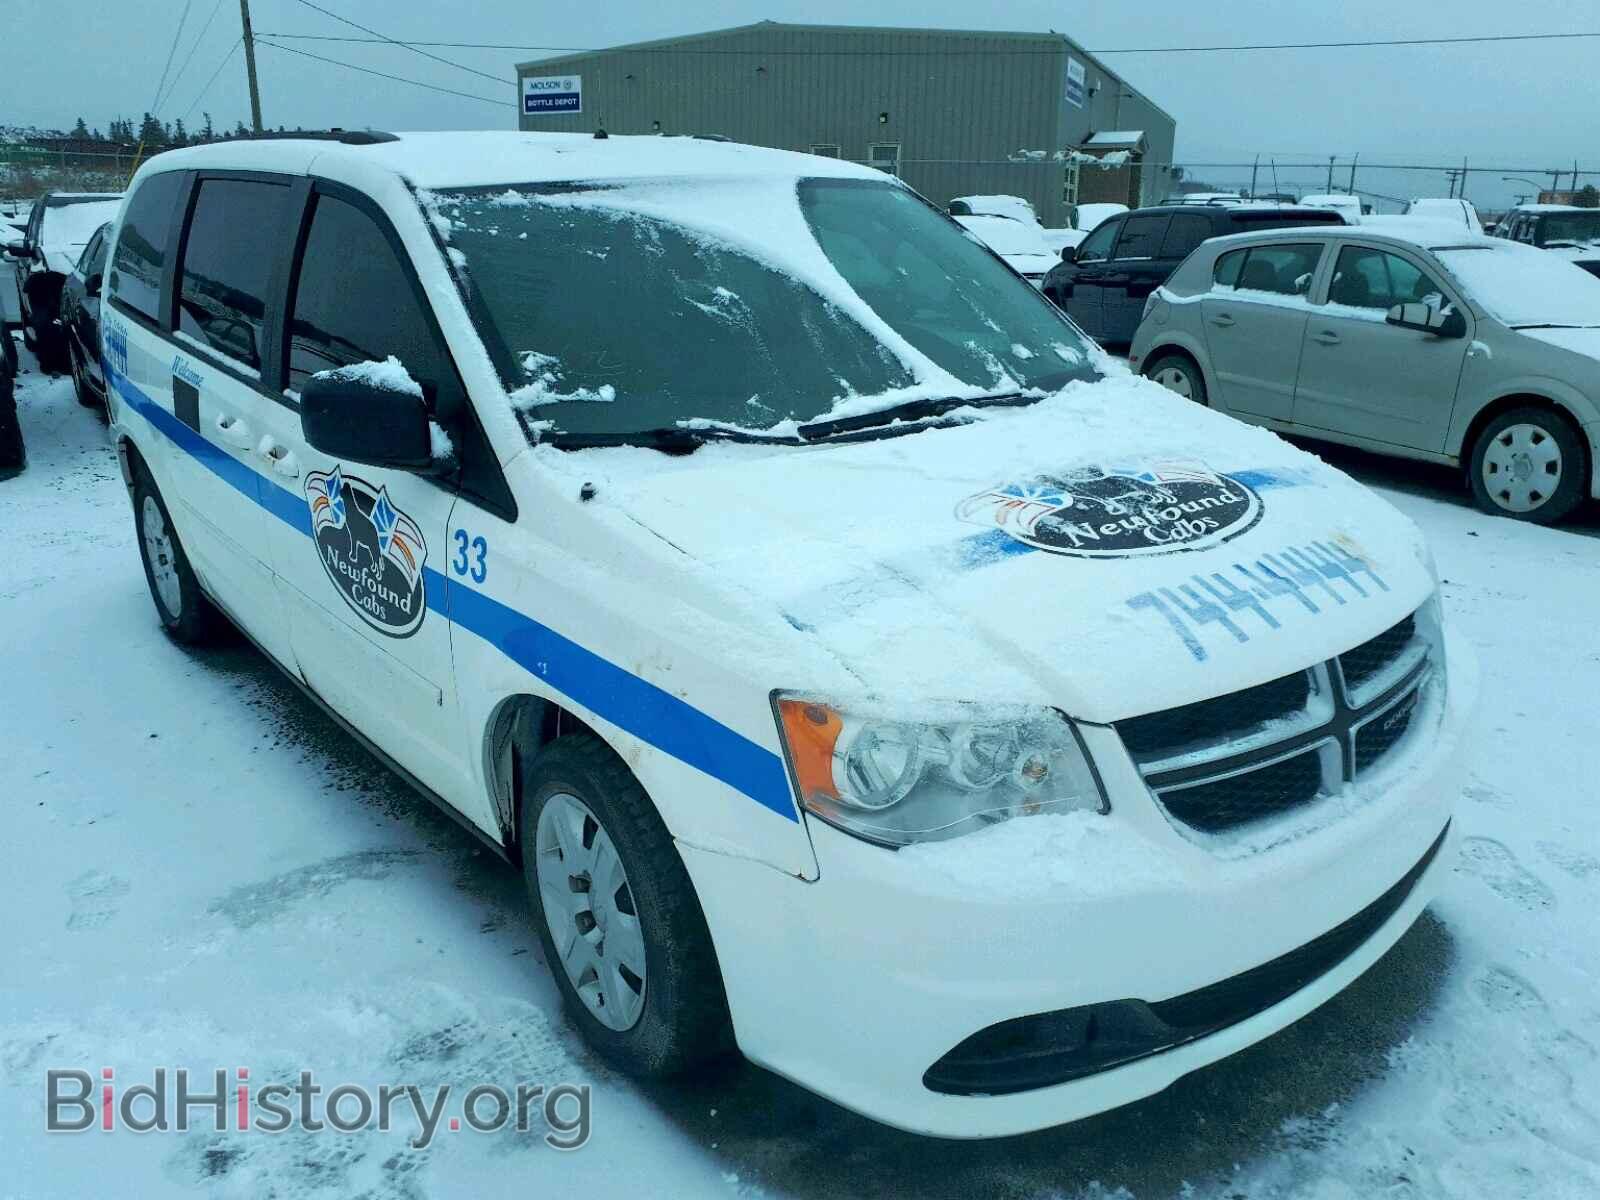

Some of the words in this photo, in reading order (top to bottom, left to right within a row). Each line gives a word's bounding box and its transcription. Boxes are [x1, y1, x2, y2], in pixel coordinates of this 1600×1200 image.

[527, 99, 553, 107] BOTTLE
[554, 98, 577, 106] DEPOT
[529, 81, 561, 90] MOLSON
[171, 354, 204, 387] Welcome
[1063, 487, 1244, 547] Newfound
[1143, 513, 1221, 545] Cabs
[453, 528, 488, 584] 33
[326, 545, 412, 615] Newfound
[351, 583, 387, 620] Cabs
